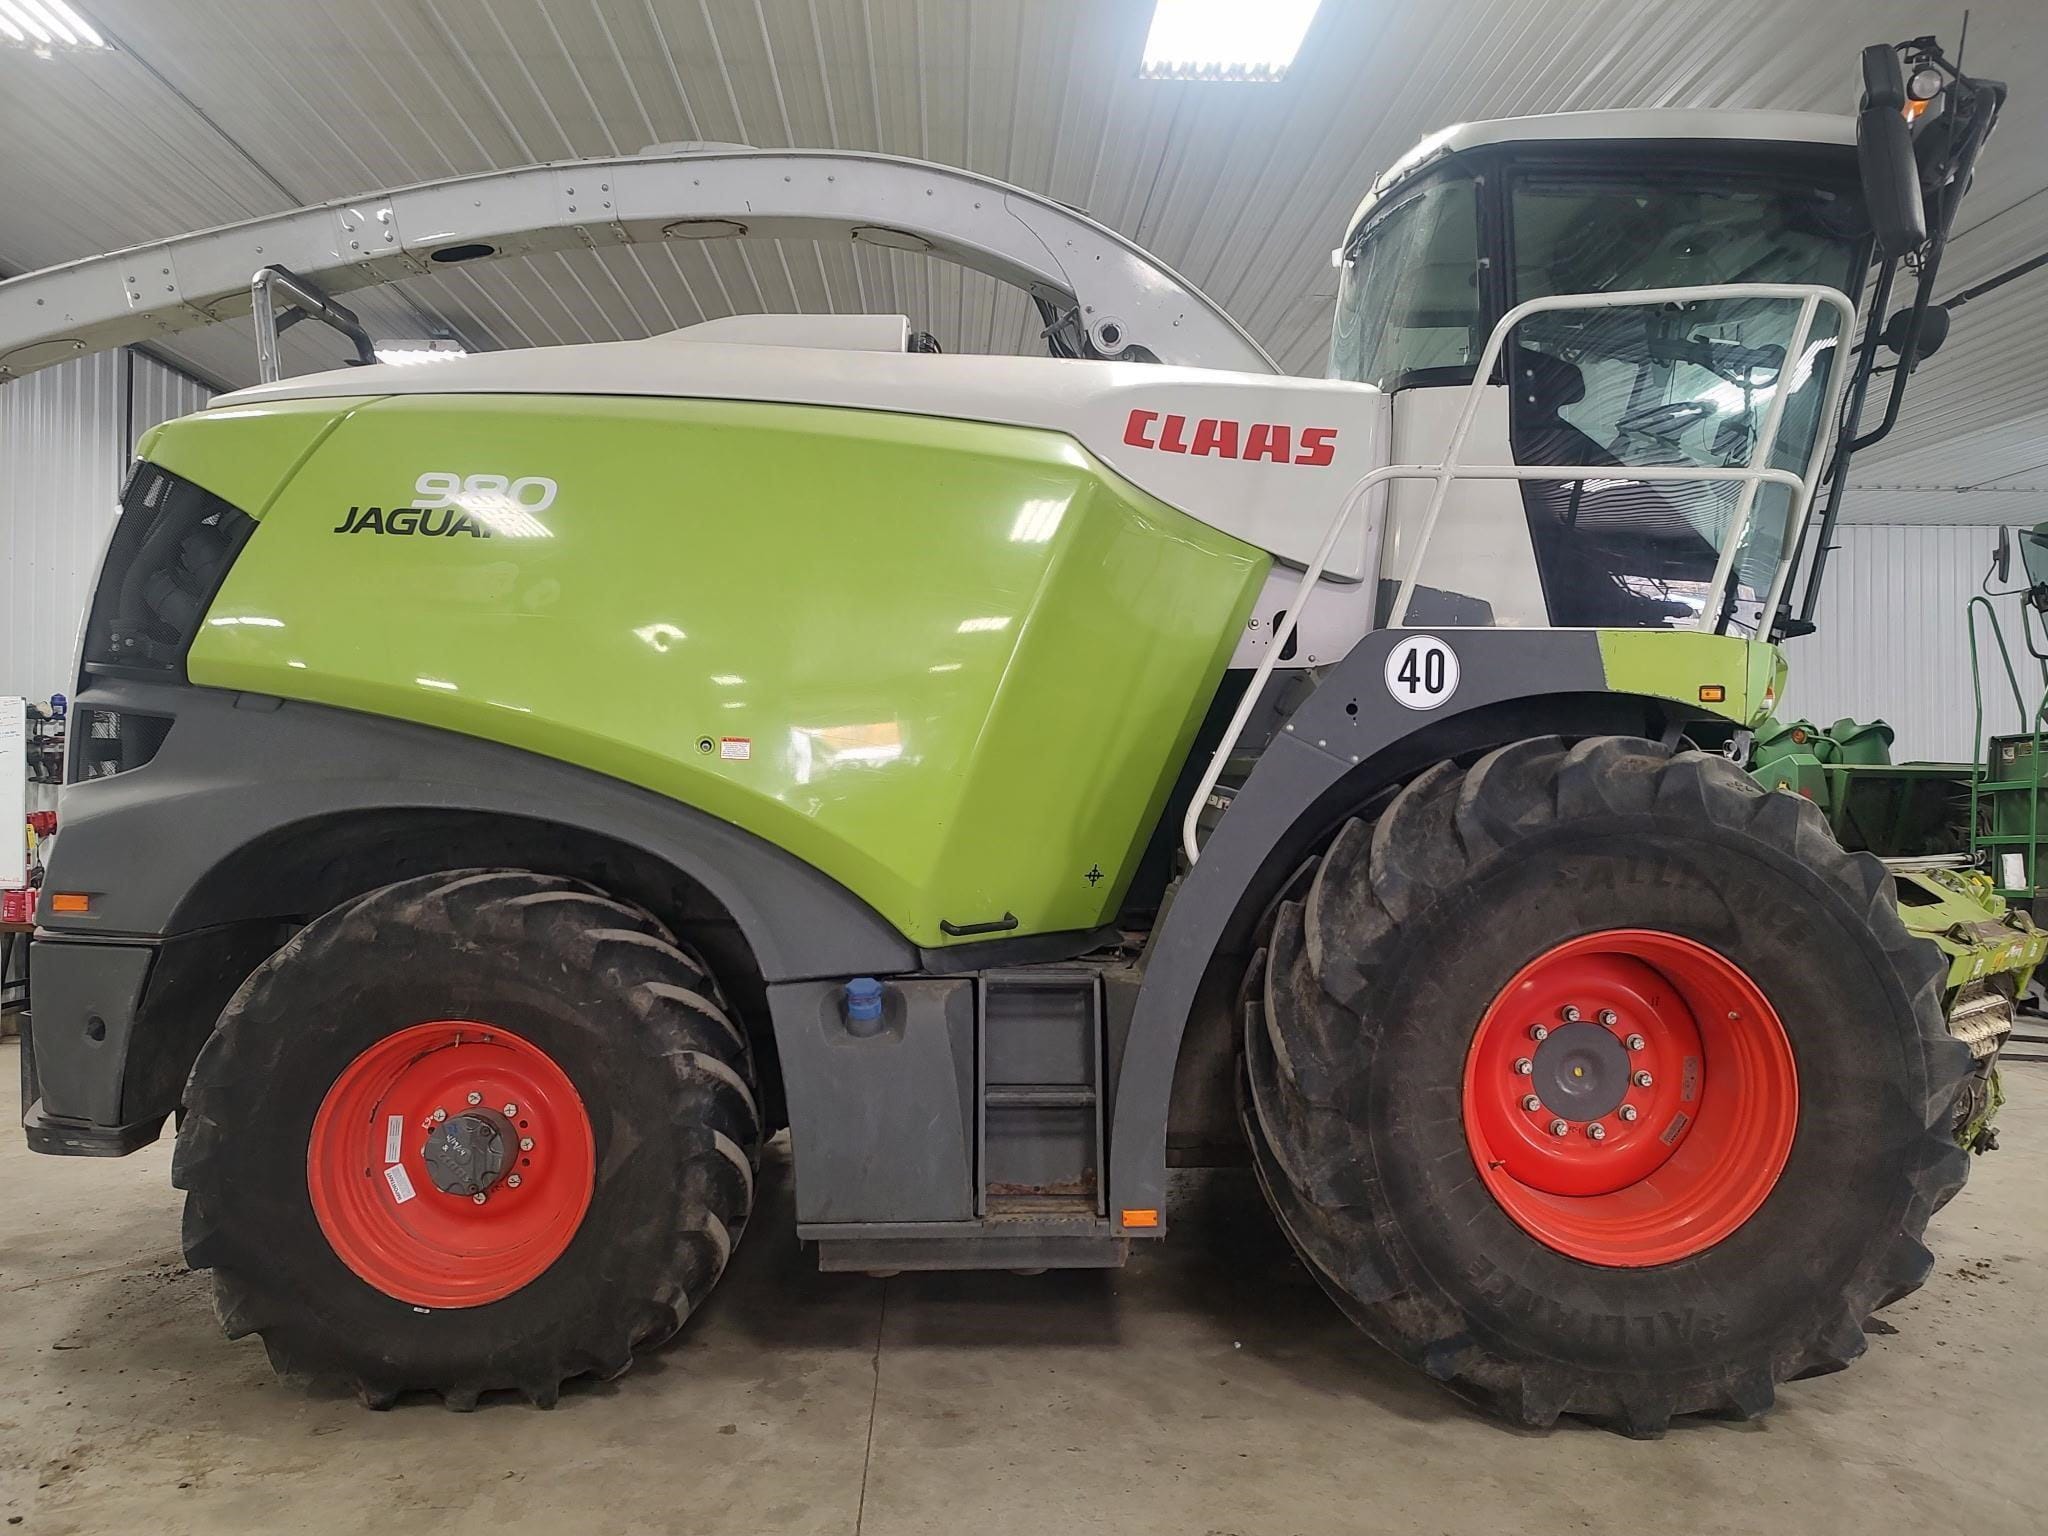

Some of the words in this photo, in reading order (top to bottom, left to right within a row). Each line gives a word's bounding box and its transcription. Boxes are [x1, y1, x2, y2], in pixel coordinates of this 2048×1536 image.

[1124, 409, 1338, 467] CLAAS
[411, 472, 558, 513] 980
[334, 507, 492, 538] JAGUA
[1397, 648, 1445, 694] 40
